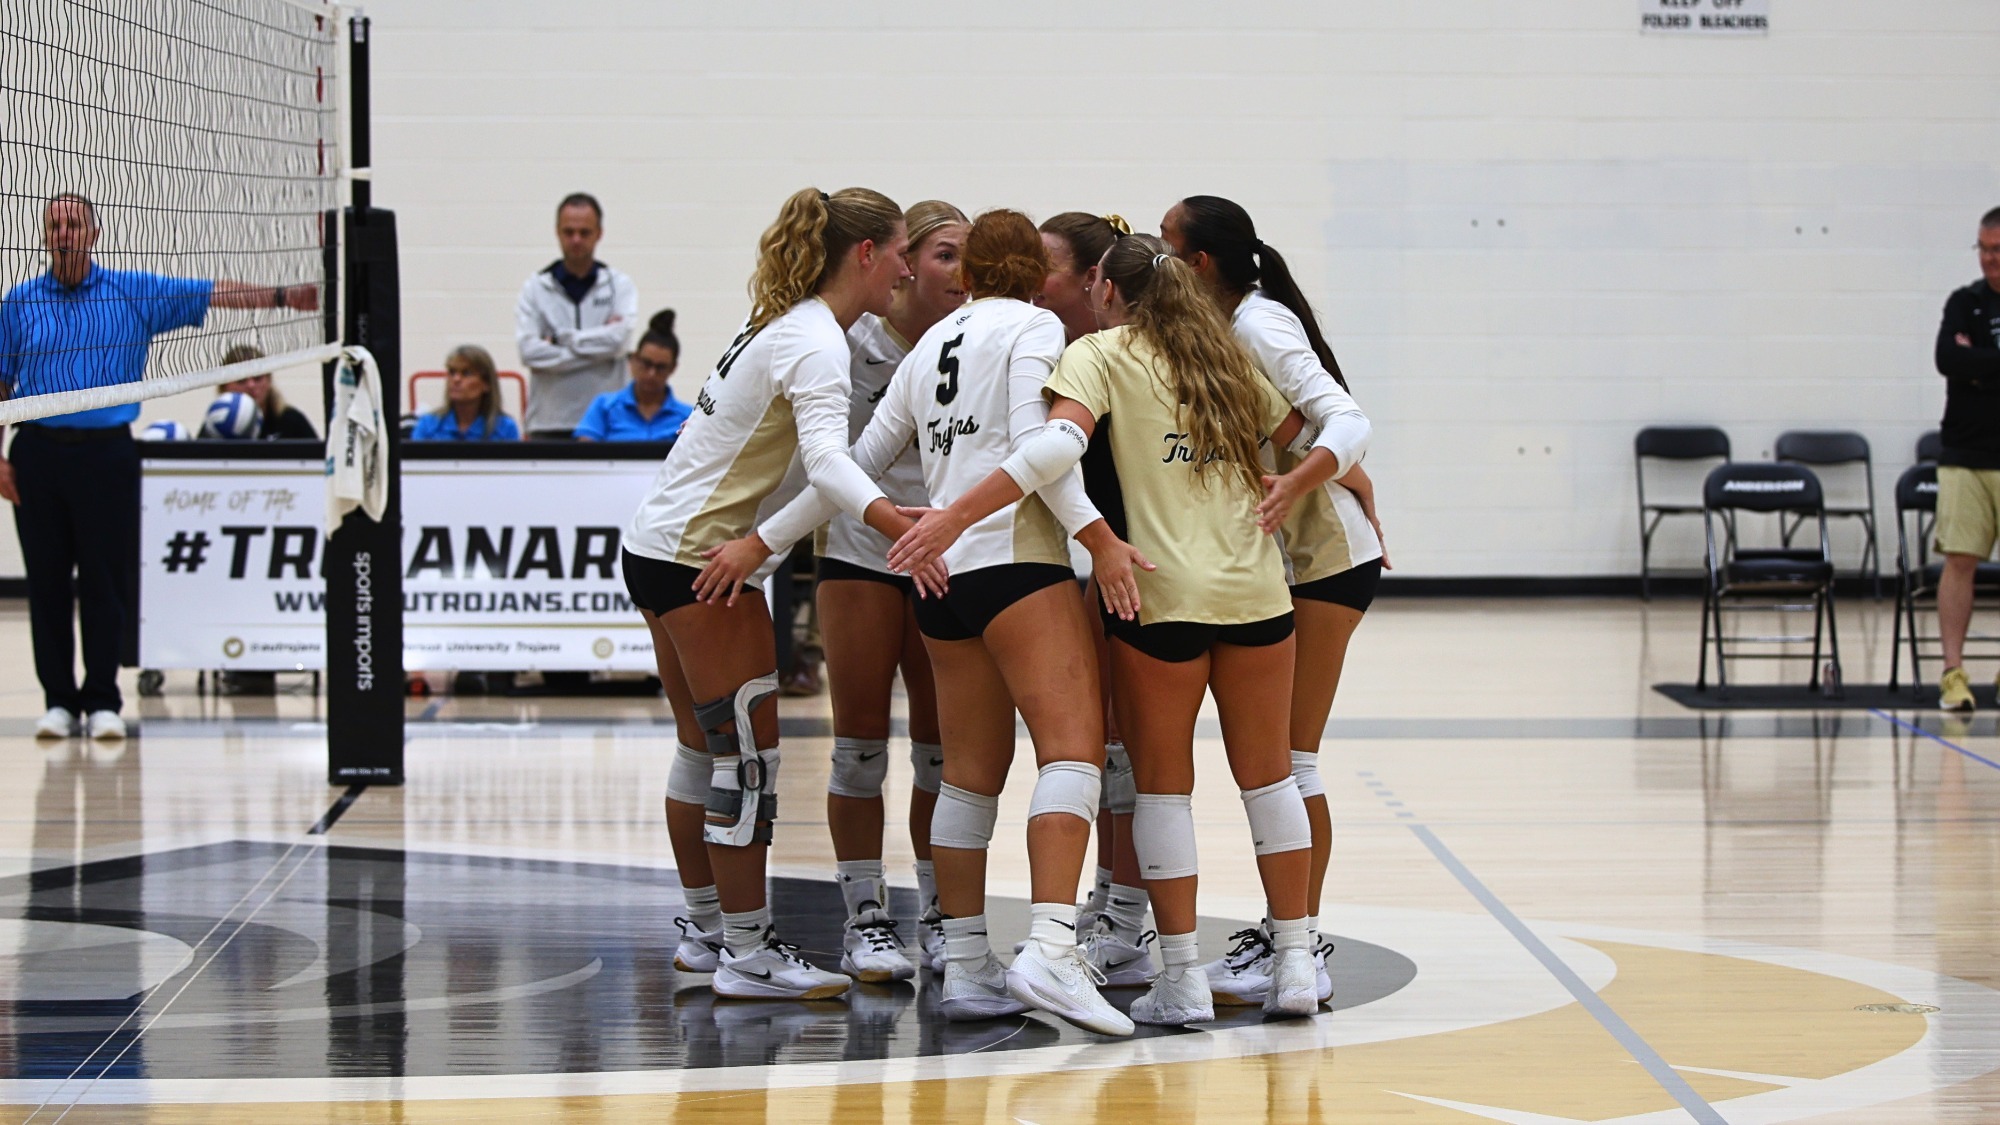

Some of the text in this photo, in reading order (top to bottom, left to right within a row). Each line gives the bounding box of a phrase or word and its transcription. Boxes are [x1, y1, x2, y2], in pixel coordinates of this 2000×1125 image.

[1642, 13, 1769, 28] FOLDED BLEACHERS
[936, 332, 965, 406] 5
[1723, 479, 1805, 492] ANDERSON
[163, 487, 299, 521] HOME OF THE
[352, 551, 375, 691] sports imports
[446, 641, 510, 654] University
[515, 640, 561, 653] Trojans
